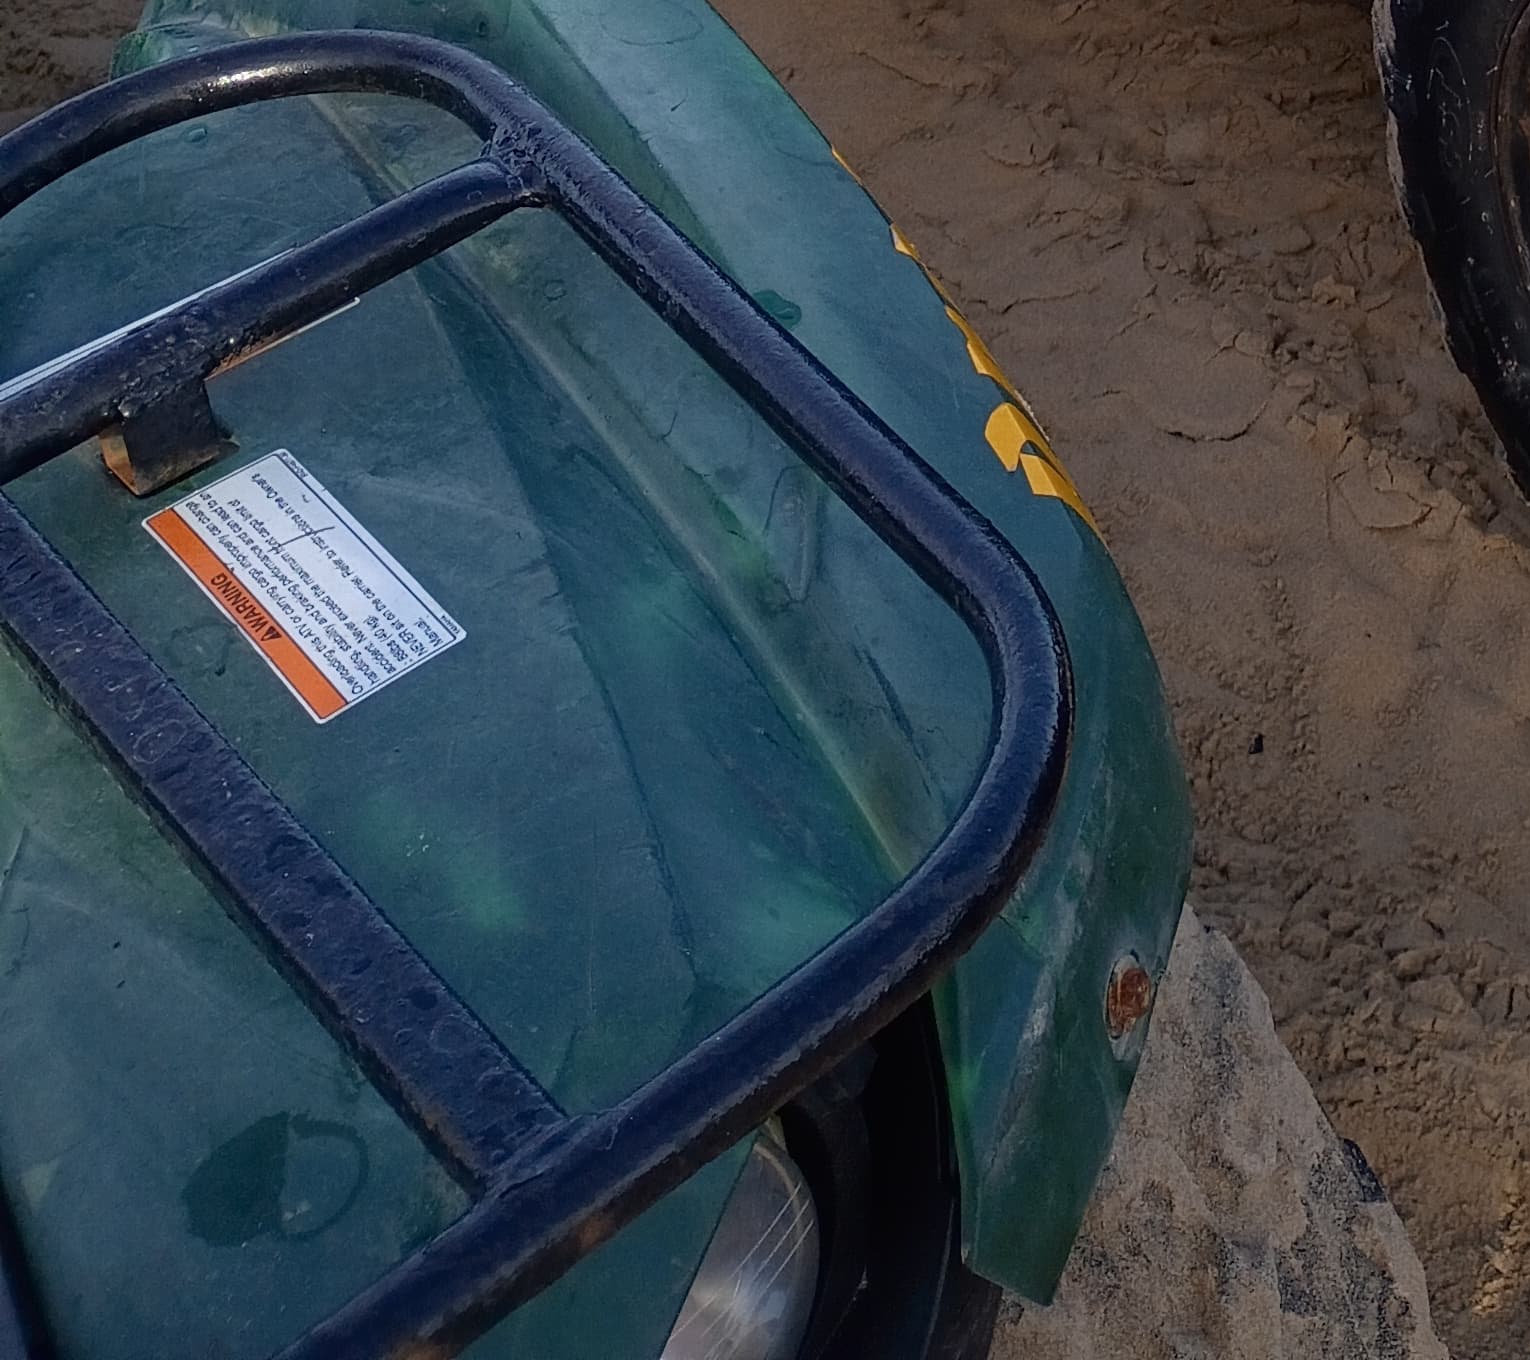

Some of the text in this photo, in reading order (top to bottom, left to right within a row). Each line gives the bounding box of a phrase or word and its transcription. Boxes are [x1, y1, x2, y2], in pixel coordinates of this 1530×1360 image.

[247, 472, 279, 499] Owner's
[203, 499, 218, 509] to
[226, 497, 241, 508] of
[270, 496, 289, 510] the
[210, 506, 231, 523] lead
[233, 505, 254, 522] limit
[279, 506, 295, 517] in
[222, 519, 242, 535] can
[245, 517, 273, 539] cargo
[233, 531, 254, 548] and
[320, 549, 337, 560] to
[245, 543, 294, 588] performance
[277, 551, 315, 587] maximum
[328, 557, 354, 578] Refer
[182, 499, 369, 695] Overloading this ATV or carrying cargo improperly can change
[283, 583, 317, 613] braking
[307, 583, 326, 598] the
[208, 571, 270, 632] WARNING
[318, 594, 349, 623] exceed
[367, 597, 387, 613] the
[306, 609, 328, 627] and
[378, 608, 396, 622] on
[341, 619, 369, 643] Never
[387, 618, 405, 631] sit
[319, 622, 355, 653] stability
[396, 628, 429, 657] NEVER
